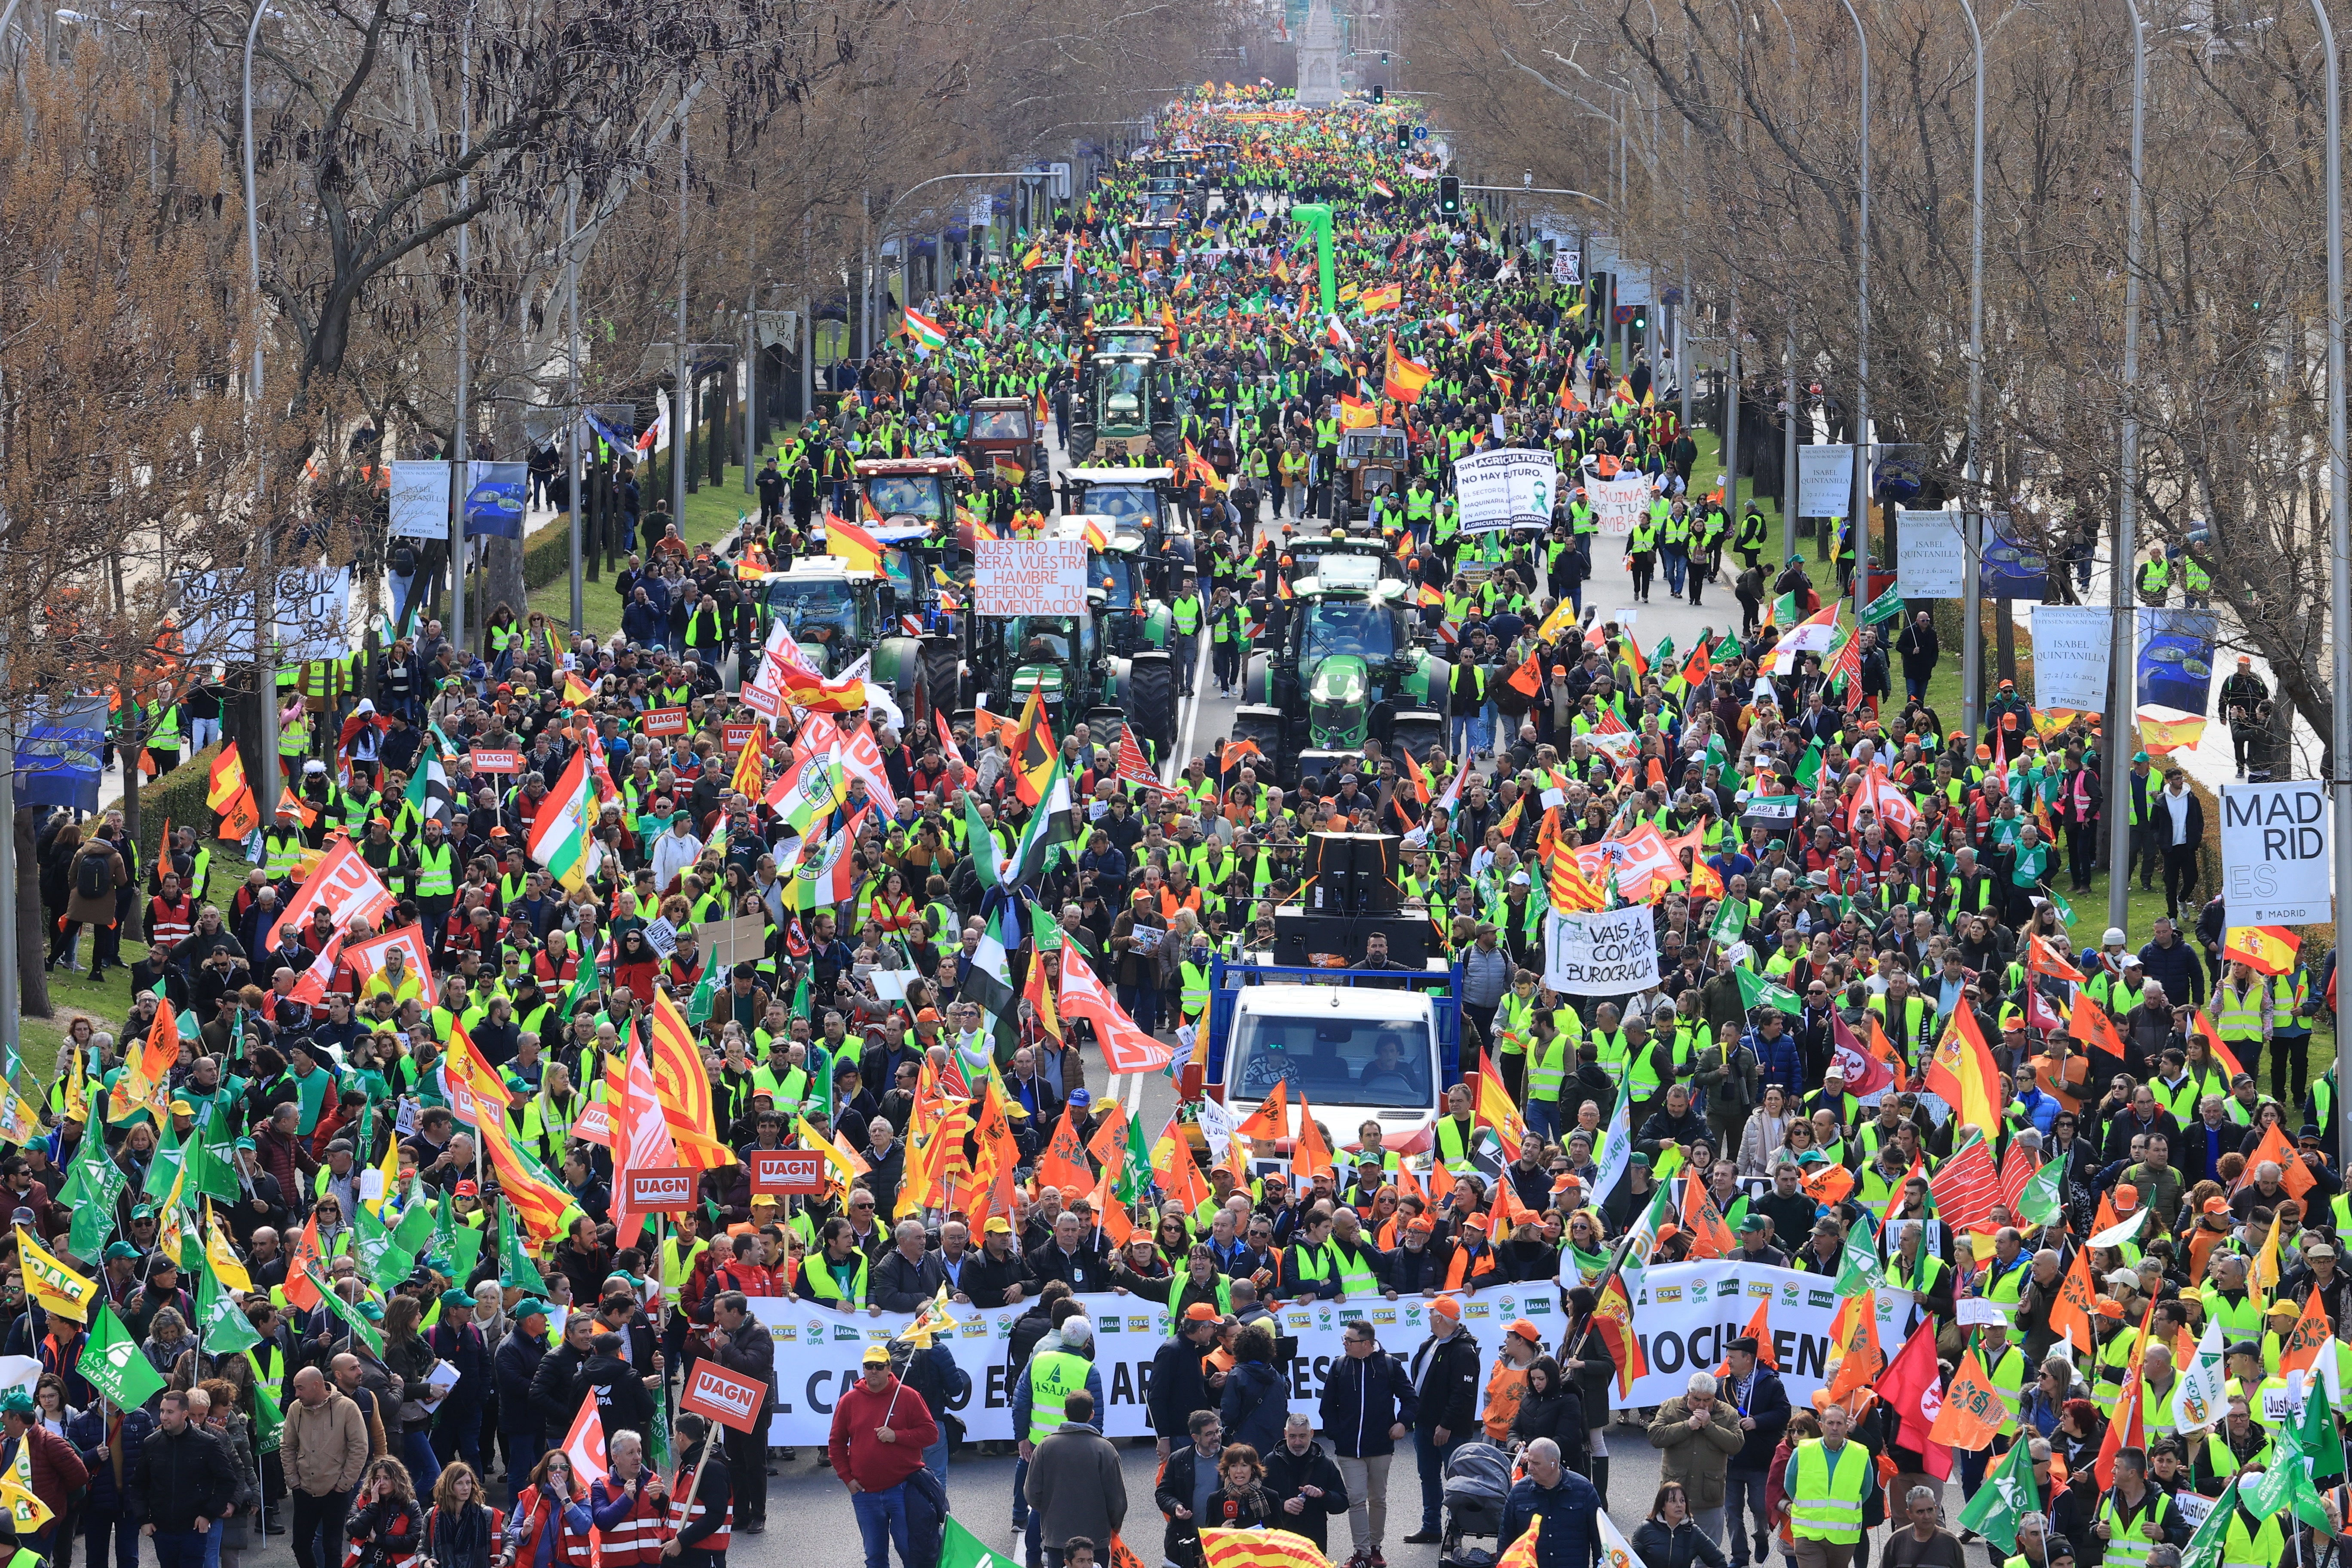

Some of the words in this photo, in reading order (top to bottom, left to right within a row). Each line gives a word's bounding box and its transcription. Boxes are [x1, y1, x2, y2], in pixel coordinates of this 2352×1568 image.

[776, 330, 791, 343] RA
[1459, 462, 1475, 471] SIN
[1478, 454, 1552, 467] AGRICULTURA,
[1462, 475, 1477, 484] NO
[1481, 472, 1500, 481] HAY
[1504, 469, 1543, 480] FUTURO.
[1473, 488, 1496, 496] SECTOR
[1596, 484, 1642, 502] RUINA
[1464, 499, 1504, 508] MAQUINARIA
[1614, 503, 1636, 514] TU
[976, 542, 1047, 554] NUESTRO
[1060, 542, 1086, 554] FIN
[1900, 551, 1960, 559] QUINTANILLA
[975, 556, 1014, 569] SERA
[1020, 556, 1087, 569] VUESTRA
[994, 571, 1058, 584] HAMBRE
[976, 585, 1043, 598] DEFIENDE
[1060, 585, 1082, 598] TU
[1873, 587, 1897, 605] ASAJA
[975, 599, 1087, 613] ALIMENTACION
[2054, 640, 2089, 649] ISABEL
[1717, 646, 1736, 660] ASAJA
[2037, 652, 2105, 662] QUINTANILLA
[747, 689, 774, 705] UAGN
[2061, 697, 2087, 706] MADRID
[649, 714, 681, 724] UAGN
[729, 731, 753, 739] UAG
[478, 754, 511, 763] UAGN
[2226, 792, 2322, 827] MAD
[2264, 827, 2323, 861] RID
[2230, 864, 2278, 899] ES
[2269, 909, 2306, 918] MADRID
[1589, 923, 1629, 944] VAIS
[1634, 917, 1642, 936] A
[1593, 931, 1651, 962] COMER
[1566, 957, 1652, 983] BUROCRACIA
[461, 1093, 497, 1115] UGN
[762, 1162, 815, 1175] UAGN
[637, 1179, 687, 1193] UAGN
[1721, 1283, 1740, 1292] ASAJA
[1782, 1298, 1798, 1307] UPA
[1812, 1295, 1833, 1305] ASAJA
[342, 1302, 368, 1334] ASAJA
[1876, 1314, 1891, 1322] UPA
[83, 1351, 123, 1387] ASAJA
[1464, 1375, 1473, 1383] HH
[2205, 1369, 2217, 1402] ASAJA
[101, 1382, 126, 1404] REAL
[699, 1375, 753, 1406] UAGN
[1034, 1381, 1072, 1396] ASAJA
[1968, 1390, 1990, 1417] UPA
[2185, 1374, 2206, 1419] COAG
